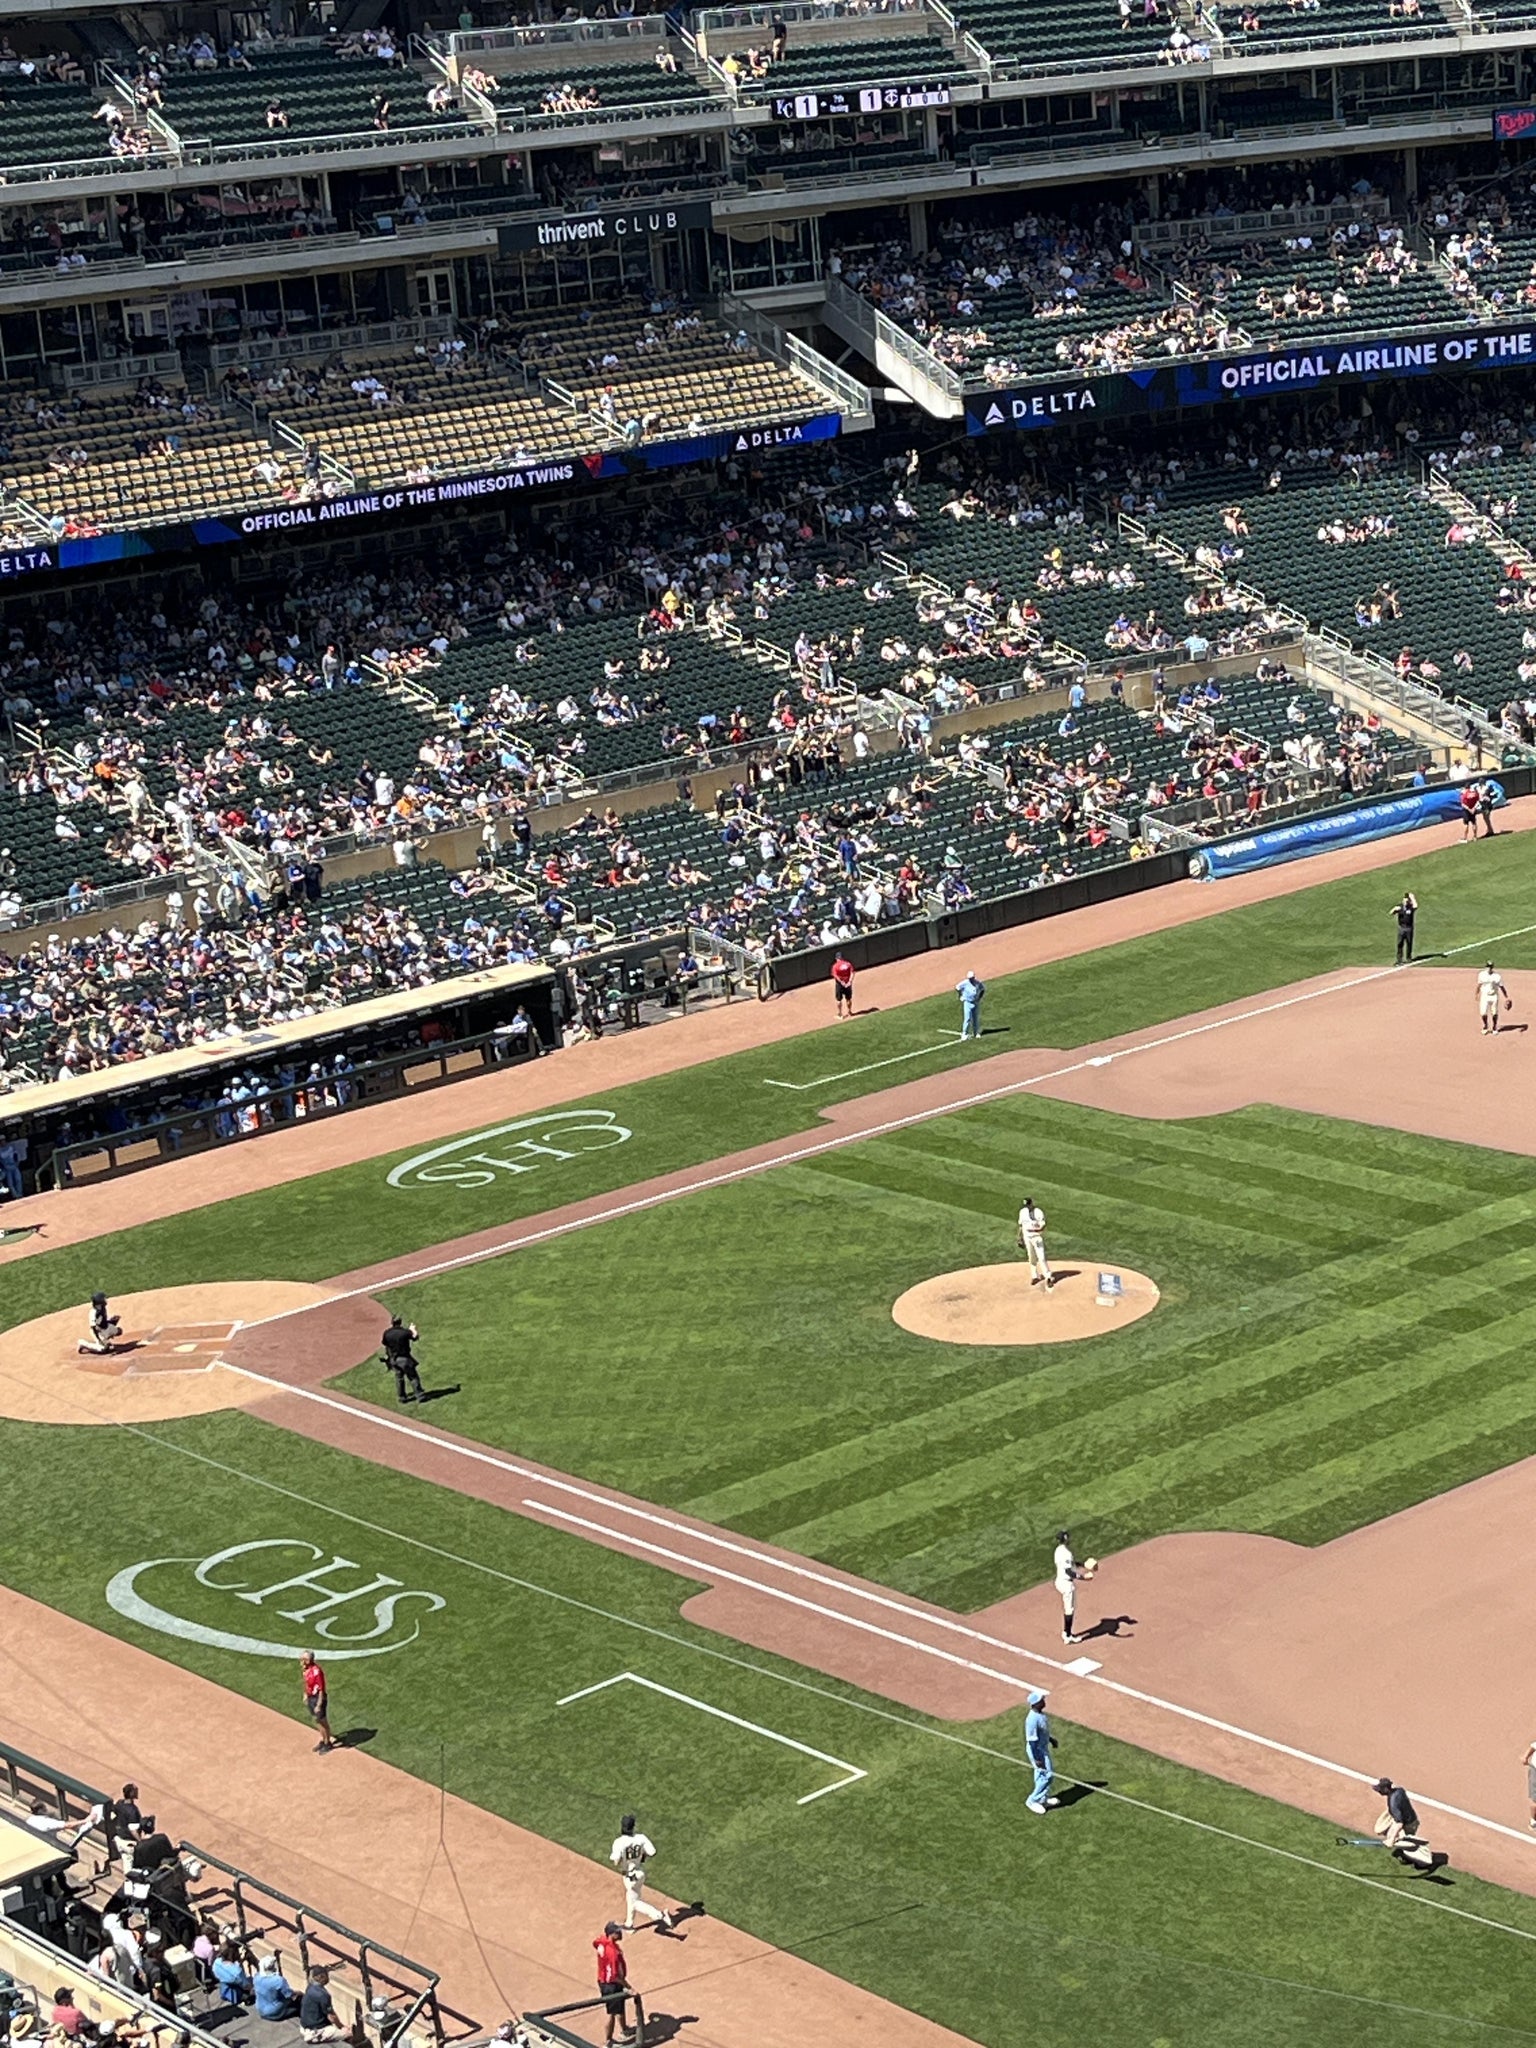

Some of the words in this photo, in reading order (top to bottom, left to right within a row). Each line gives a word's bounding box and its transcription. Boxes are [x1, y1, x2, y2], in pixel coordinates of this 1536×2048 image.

[776, 98, 793, 118] KC
[537, 218, 606, 244] thrivent
[615, 211, 677, 235] CLUB
[1221, 355, 1330, 388] OFFICIAL
[1336, 342, 1438, 375] AIRLINE
[1443, 337, 1479, 361] OF
[1483, 333, 1532, 357] THE
[1011, 389, 1096, 419] DELTA
[751, 425, 803, 447] DELTA
[241, 507, 316, 533] OFFICIAL
[319, 496, 380, 521] AIRLINE
[382, 492, 404, 509] OF
[407, 488, 436, 505] THE
[438, 473, 524, 500] MINNESOTA
[526, 464, 574, 486] TWINS
[416, 1124, 633, 1189] CHS
[194, 1539, 446, 1642] CHS
